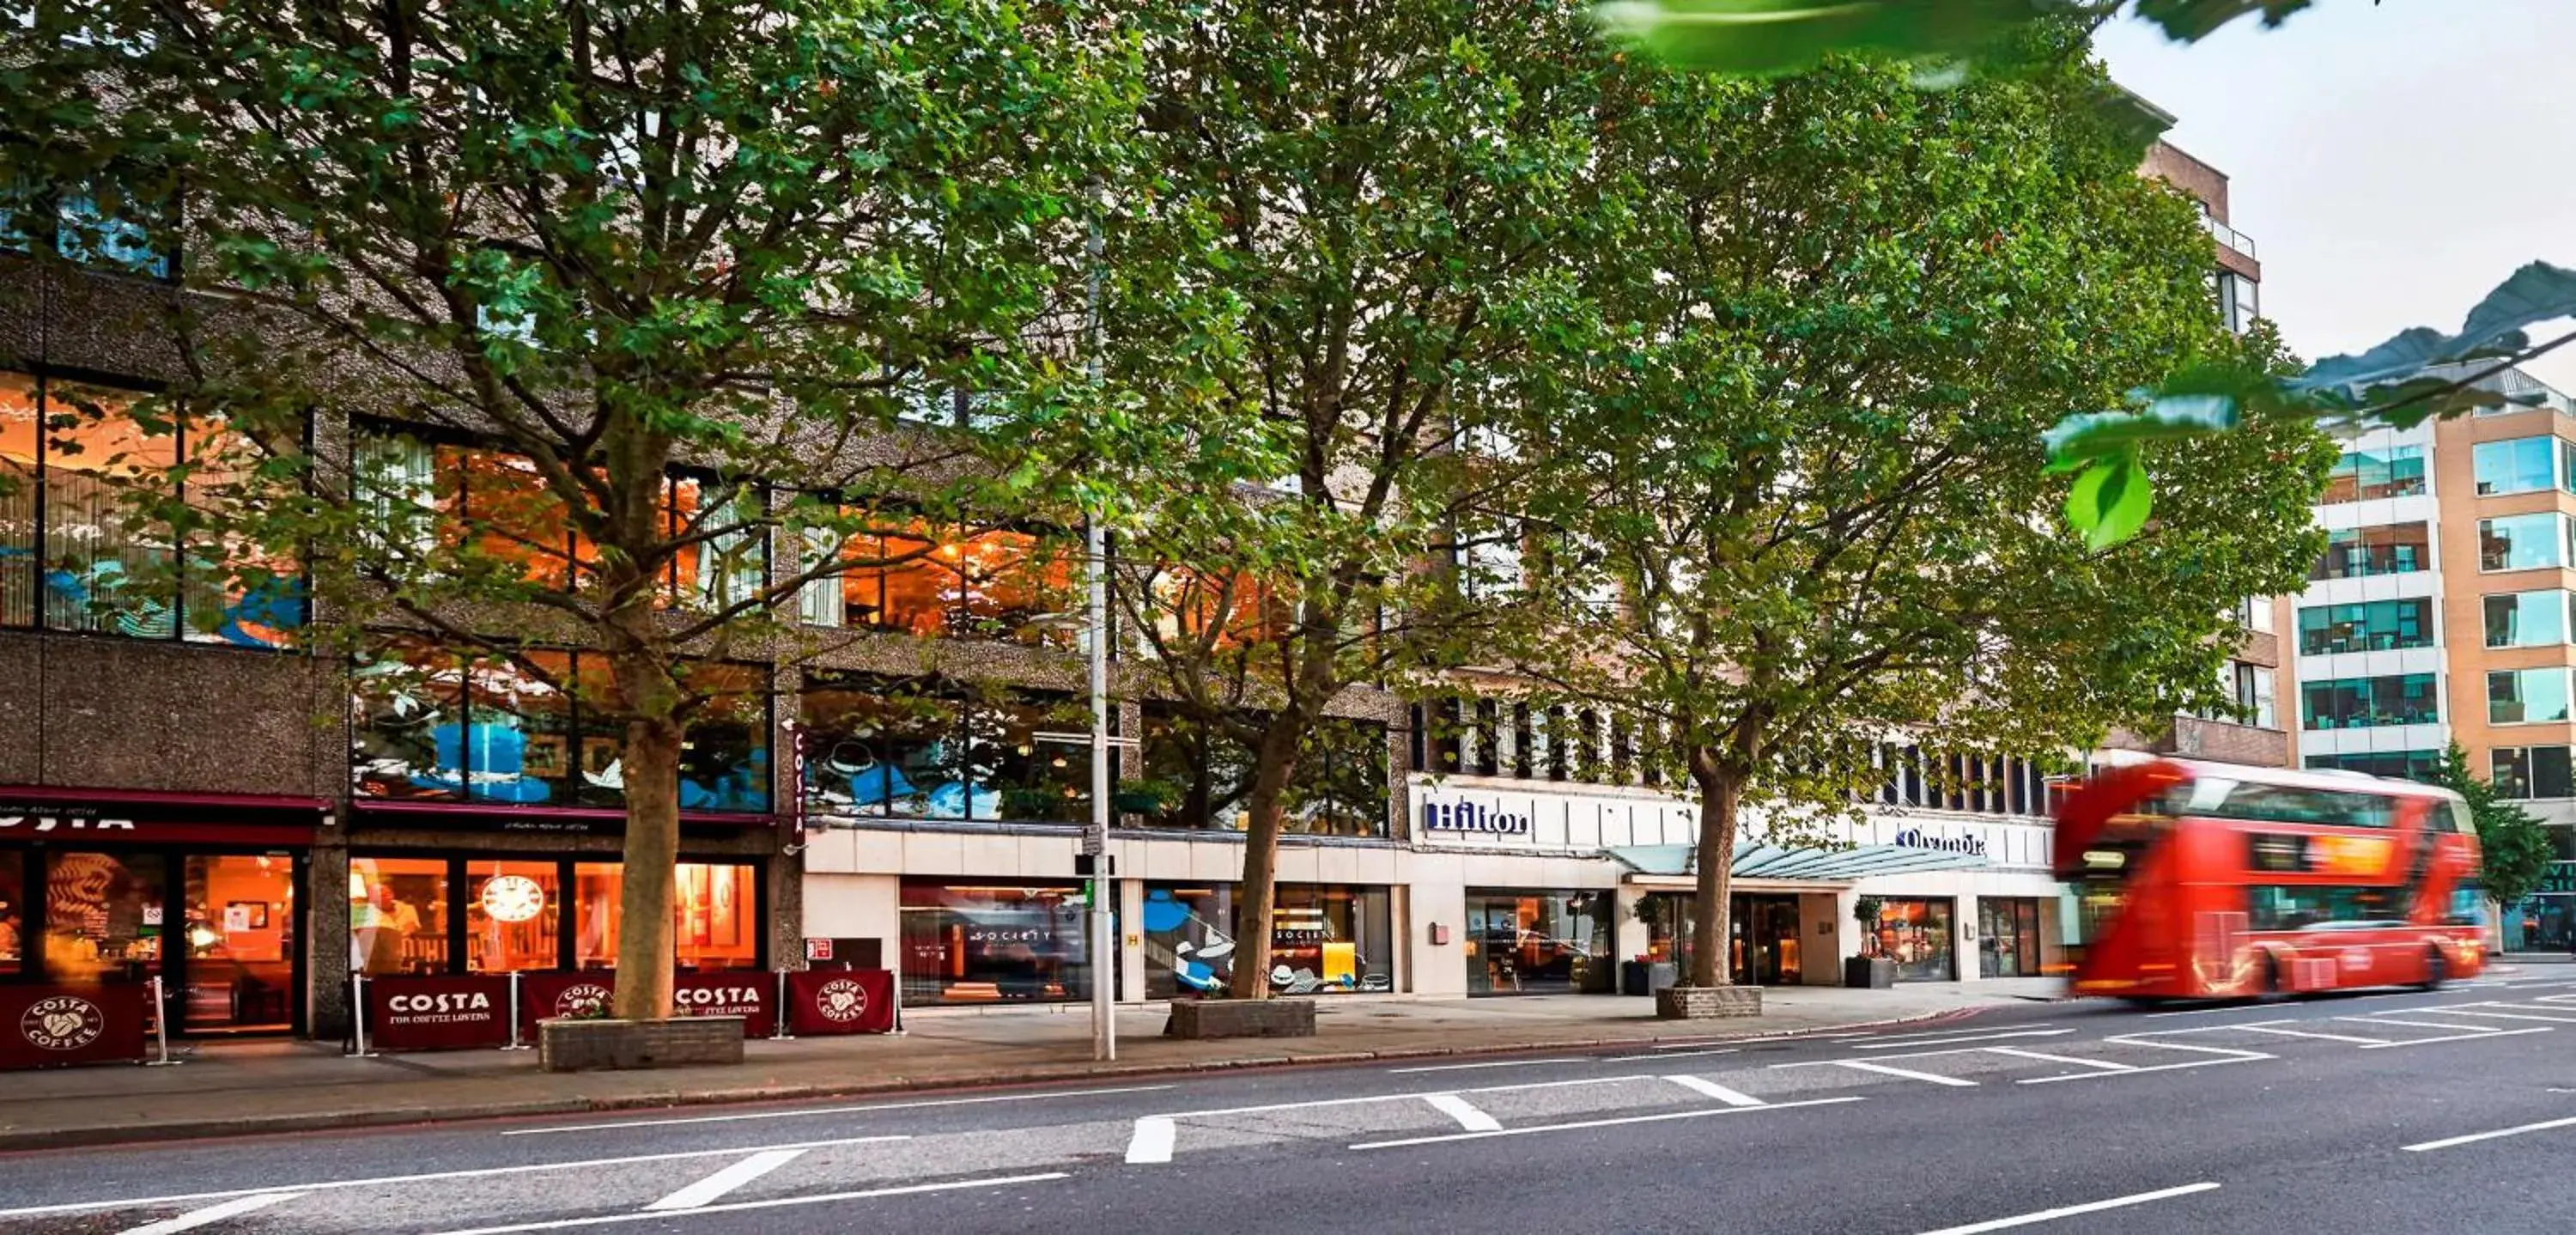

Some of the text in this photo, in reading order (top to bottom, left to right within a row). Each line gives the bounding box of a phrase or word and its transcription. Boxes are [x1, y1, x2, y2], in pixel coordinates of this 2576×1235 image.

[795, 733, 804, 832] COSTA
[1426, 802, 1528, 834] Hilton
[974, 930, 1050, 941] SOCIETY
[565, 987, 605, 1000] COSTA
[824, 982, 859, 994] COSTA
[389, 992, 489, 1013] COSTA
[676, 988, 760, 1005] COSTA
[33, 999, 88, 1015] COSTA
[453, 1013, 490, 1021] LOVERS
[29, 1027, 97, 1047] COFFEE
